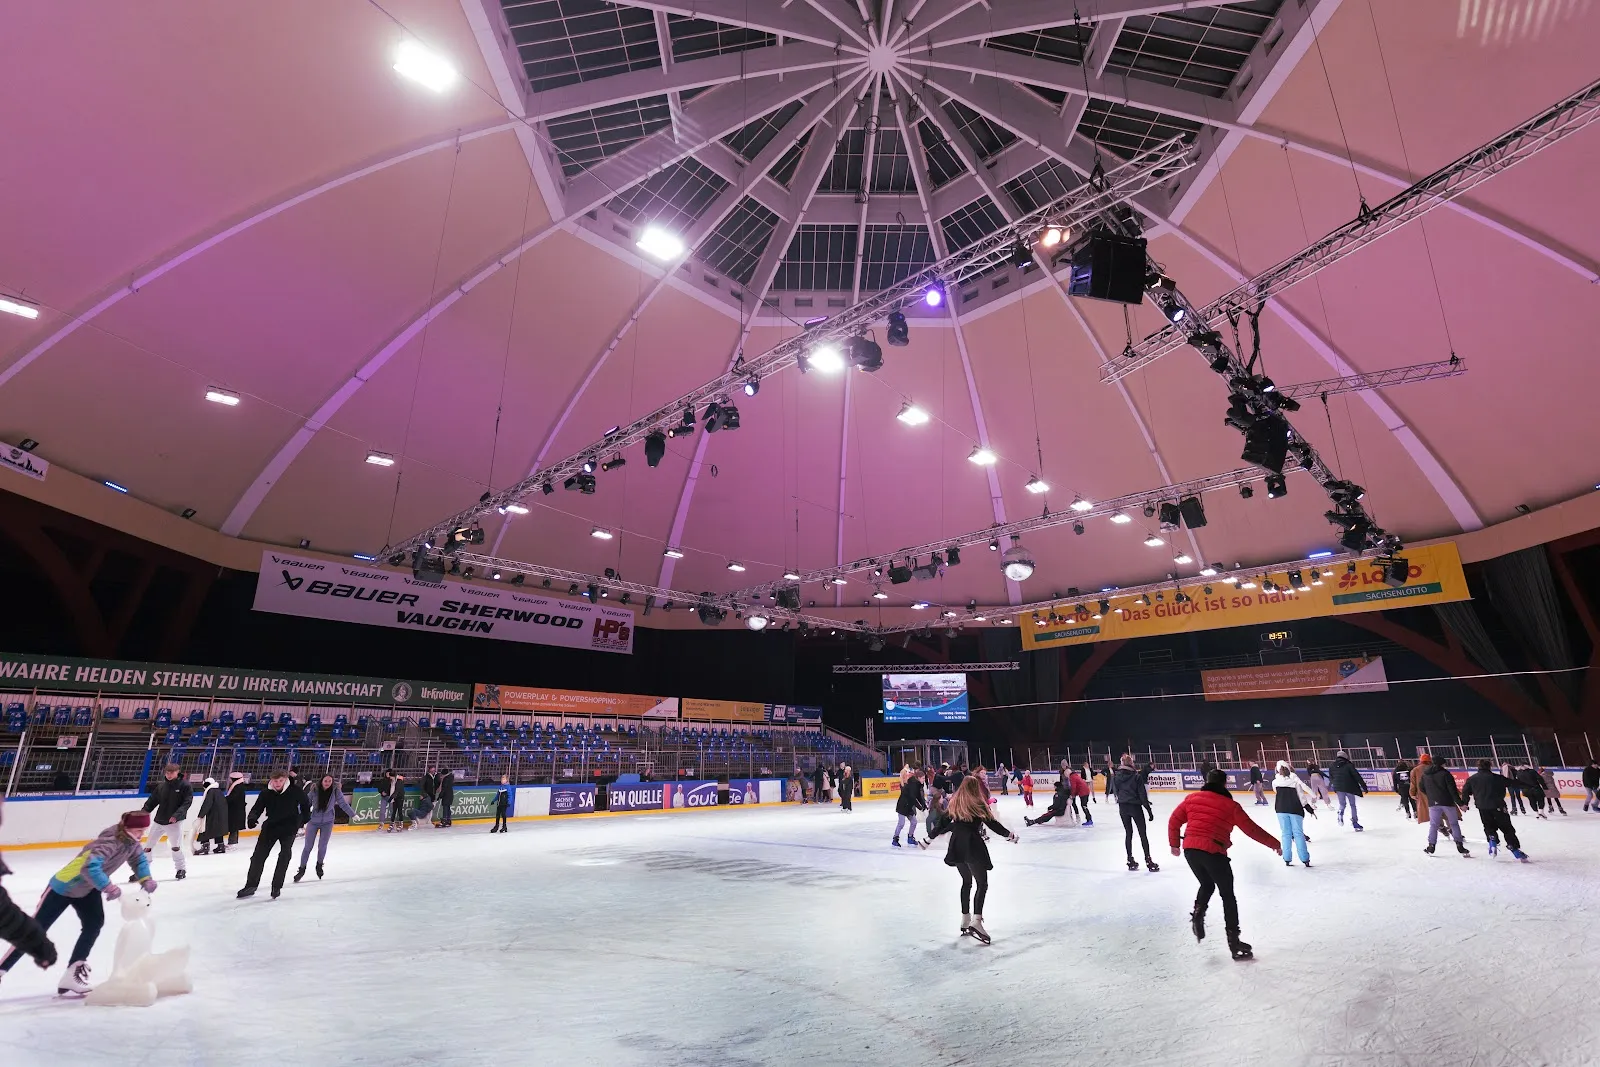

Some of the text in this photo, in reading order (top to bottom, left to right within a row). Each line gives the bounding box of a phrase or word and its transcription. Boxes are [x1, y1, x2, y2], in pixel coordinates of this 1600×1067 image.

[1362, 565, 1422, 585] LOO
[1366, 586, 1428, 600] SACHSENLOTTO
[440, 600, 584, 629] SHERWOOD
[1122, 608, 1151, 622] Das
[1154, 599, 1202, 618] Glück
[1204, 596, 1228, 612] ist
[1231, 594, 1253, 608] so
[397, 610, 495, 634] VAUGHN
[1054, 628, 1092, 638] SACHSENLOTTO
[0, 661, 384, 697] WAHRE HELDEN STEHEN ZU IHRER MANNSCHAFT
[504, 691, 550, 701] POWERPLAY
[560, 695, 617, 705] POWERSHOPPING
[1557, 779, 1584, 790] pos
[458, 796, 486, 806] SIMPLY
[556, 801, 573, 809] QUELLE
[578, 791, 596, 808] SA
[628, 789, 663, 808] QUELLE
[449, 804, 490, 816] SAXONY.
